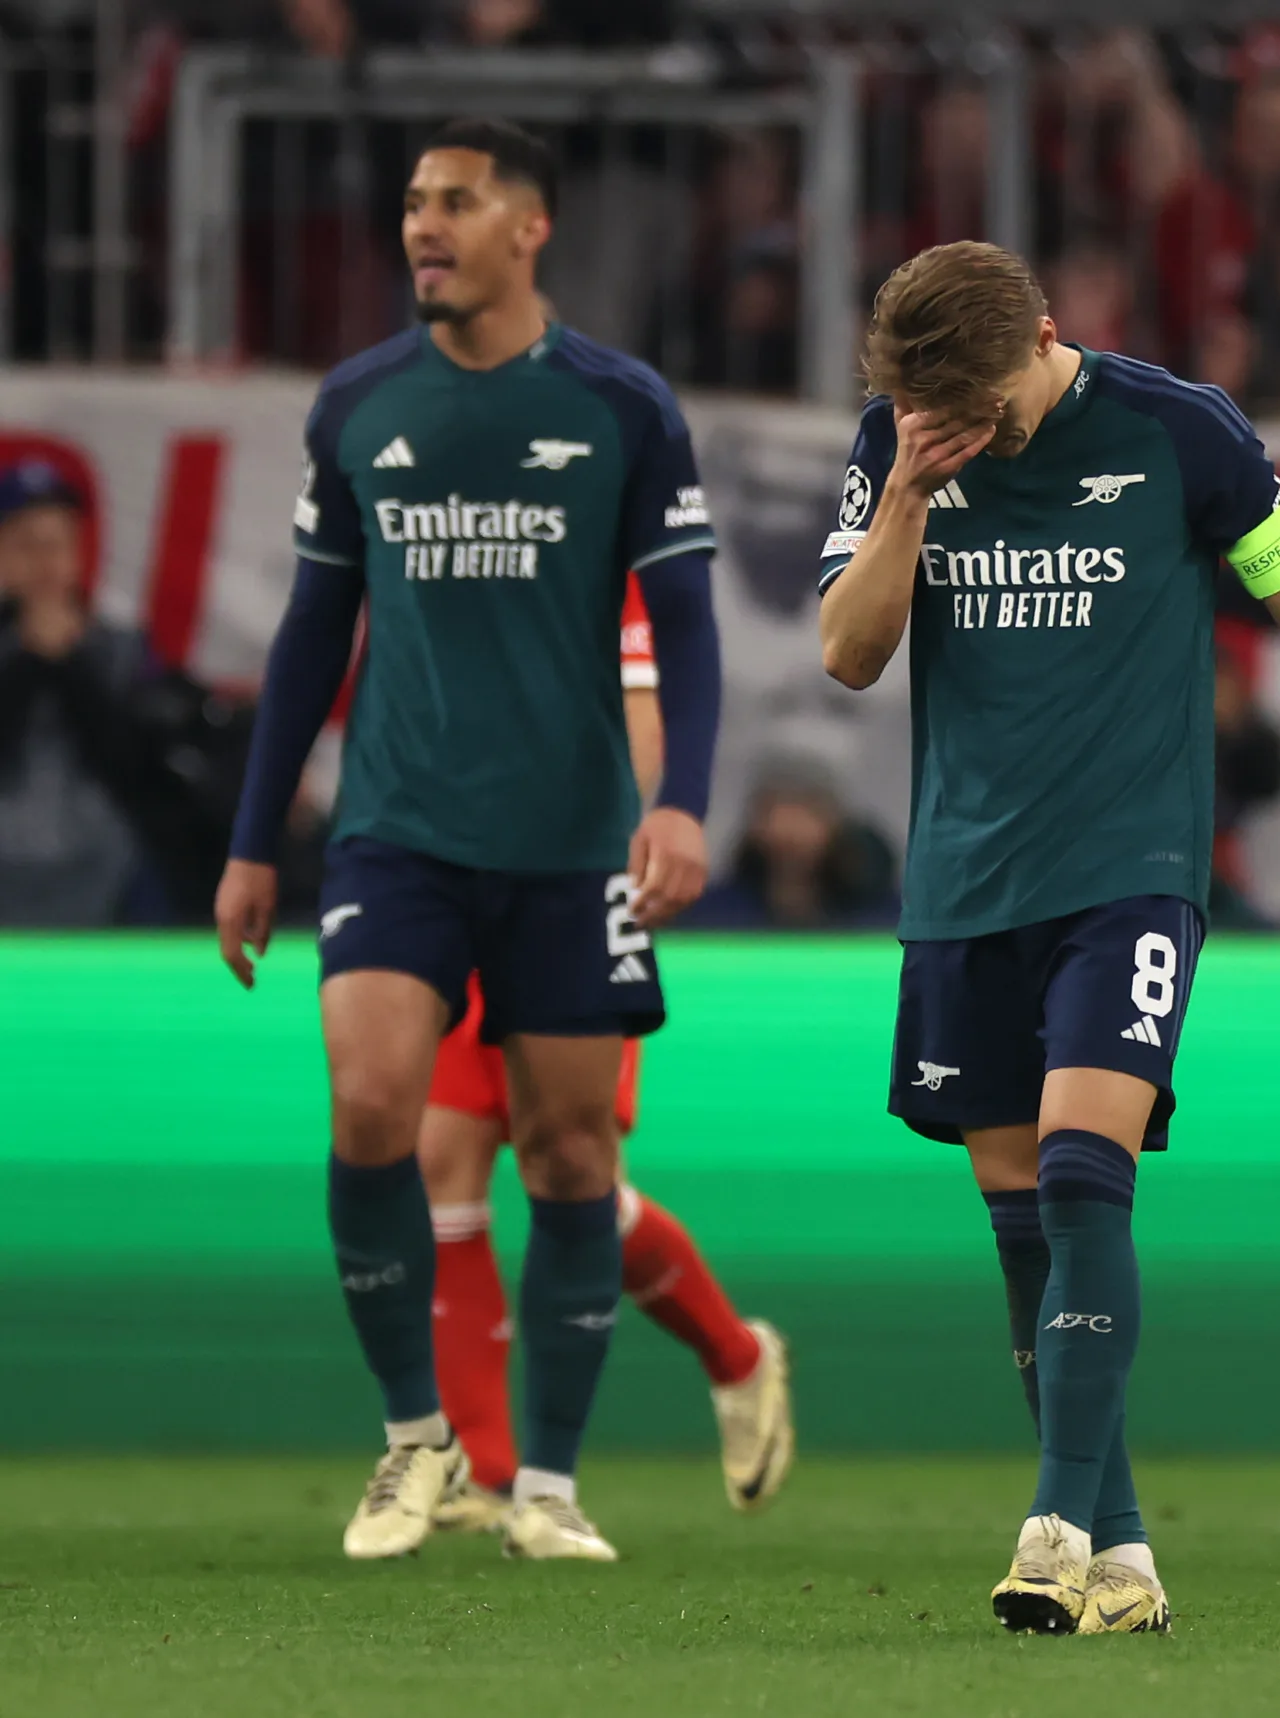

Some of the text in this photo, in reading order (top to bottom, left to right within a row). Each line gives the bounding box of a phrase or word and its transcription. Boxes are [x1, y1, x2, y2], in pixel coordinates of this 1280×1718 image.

[374, 493, 567, 543] Emirates
[404, 541, 539, 581] FLY BETTER
[920, 539, 1127, 587] Emirates
[953, 590, 1094, 630] FLY BETTER
[1130, 930, 1178, 1018] 8
[1043, 1311, 1113, 1334] AFC
